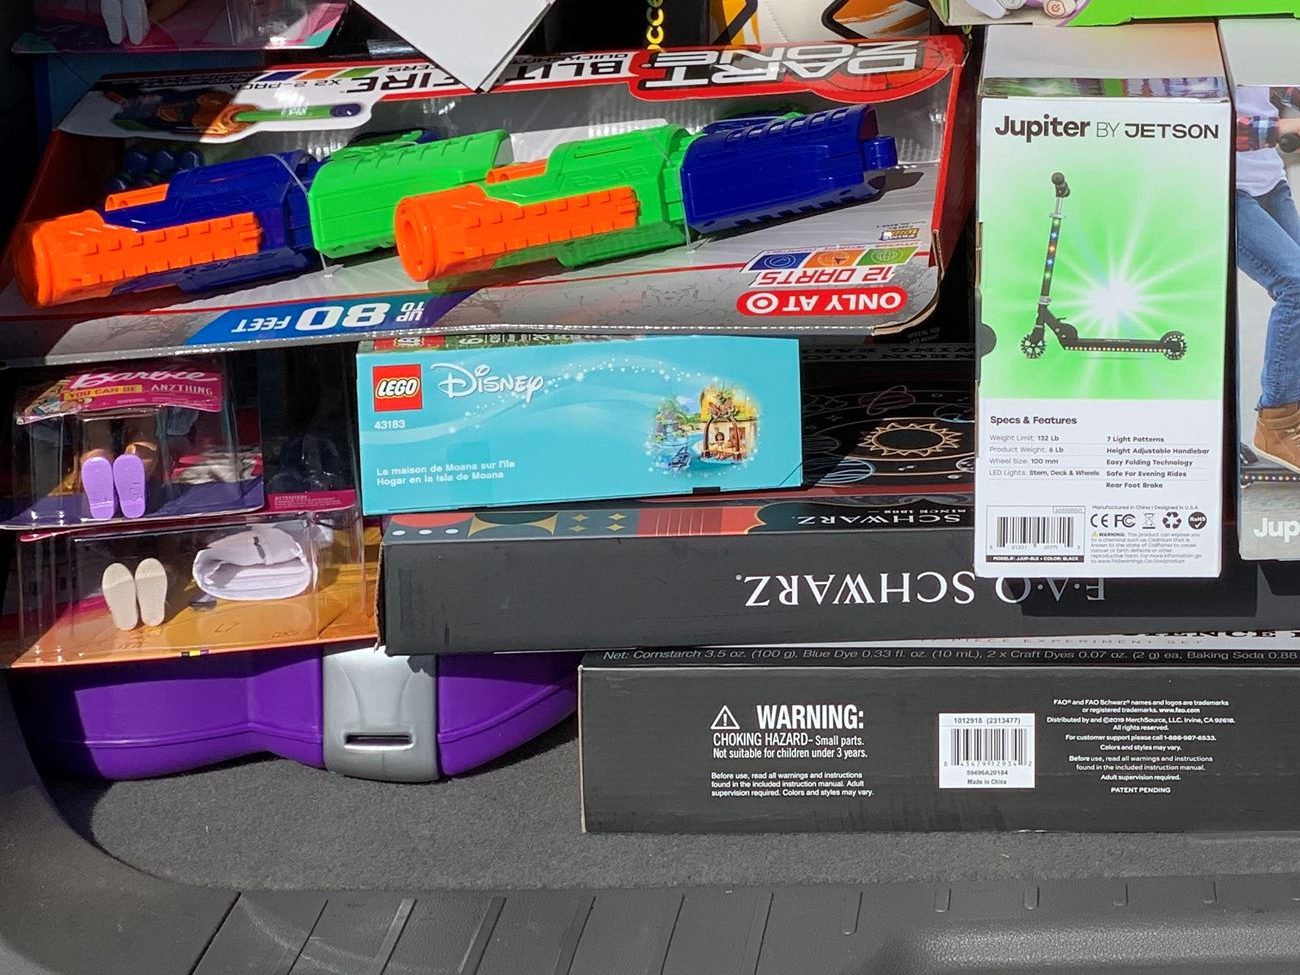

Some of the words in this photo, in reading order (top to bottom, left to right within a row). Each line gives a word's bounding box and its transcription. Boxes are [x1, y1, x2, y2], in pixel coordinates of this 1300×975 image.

[655, 39, 922, 67] ZONE
[645, 54, 919, 88] DART
[995, 114, 1091, 143] Jupiter
[1096, 122, 1120, 138] BY
[1124, 122, 1220, 141] JETSON
[757, 267, 853, 285] DARTS
[862, 266, 893, 282] 12
[401, 301, 425, 311] TO
[781, 294, 820, 311] AT
[825, 292, 902, 311] ONLY
[231, 316, 292, 333] FEET
[295, 302, 391, 331] 80
[395, 310, 422, 322] UP
[376, 379, 419, 397] LEGO
[374, 419, 406, 430] 43183
[990, 415, 1021, 426] Specs
[1033, 415, 1078, 425] Features
[1106, 447, 1132, 455] Height
[1133, 447, 1172, 456] Adjustable
[1172, 447, 1210, 455] Handlebar
[391, 465, 428, 475] maison
[445, 463, 477, 472] Moana
[1106, 459, 1123, 467] Easy
[1125, 459, 1151, 467] Folding
[1152, 459, 1194, 468] Technology
[376, 477, 407, 488] Hogar
[472, 471, 504, 480] Moana
[744, 570, 976, 607] SCHWARZ
[603, 651, 630, 660] Net:
[633, 650, 701, 659] Cornstarch
[803, 649, 832, 659] Blue
[834, 650, 859, 661] Dye
[756, 704, 864, 730] WARNING:
[953, 717, 983, 725] 1012918
[986, 717, 1021, 726] (2313477)
[713, 731, 762, 747] CHOKING
[765, 732, 814, 747] HAZARD-
[815, 735, 839, 746] Small
[840, 735, 865, 748] parts.
[713, 747, 727, 758] Not
[728, 747, 762, 758] suitable
[764, 747, 775, 758] for
[776, 747, 810, 758] children
[811, 748, 835, 758] under
[843, 750, 868, 760] years.
